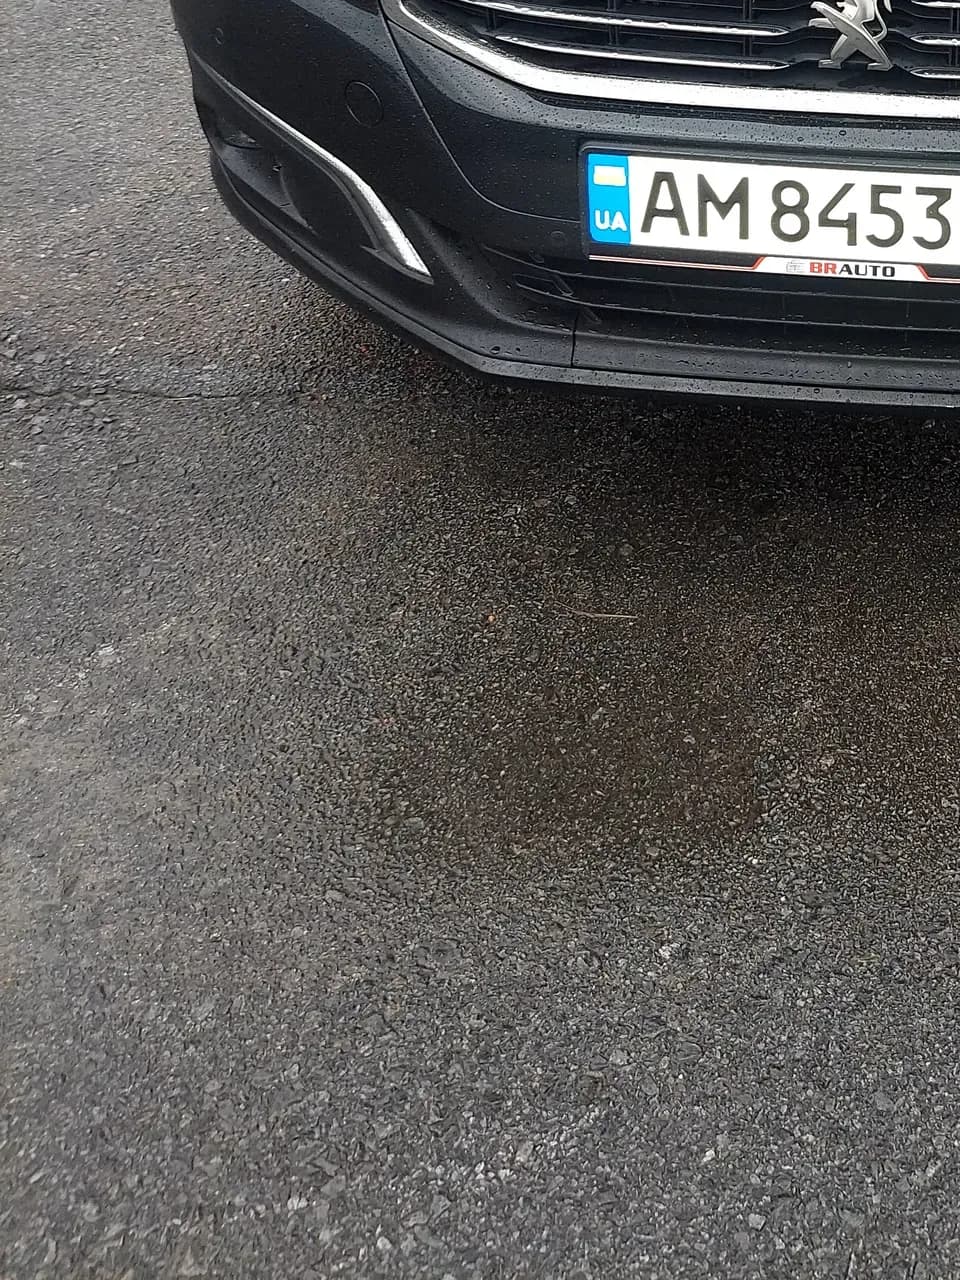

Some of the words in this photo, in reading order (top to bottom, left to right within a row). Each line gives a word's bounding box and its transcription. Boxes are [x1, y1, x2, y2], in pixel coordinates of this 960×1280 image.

[594, 209, 627, 231] UA
[640, 171, 749, 240] AM
[770, 179, 952, 251] 8453
[809, 261, 896, 278] BRAUTO
